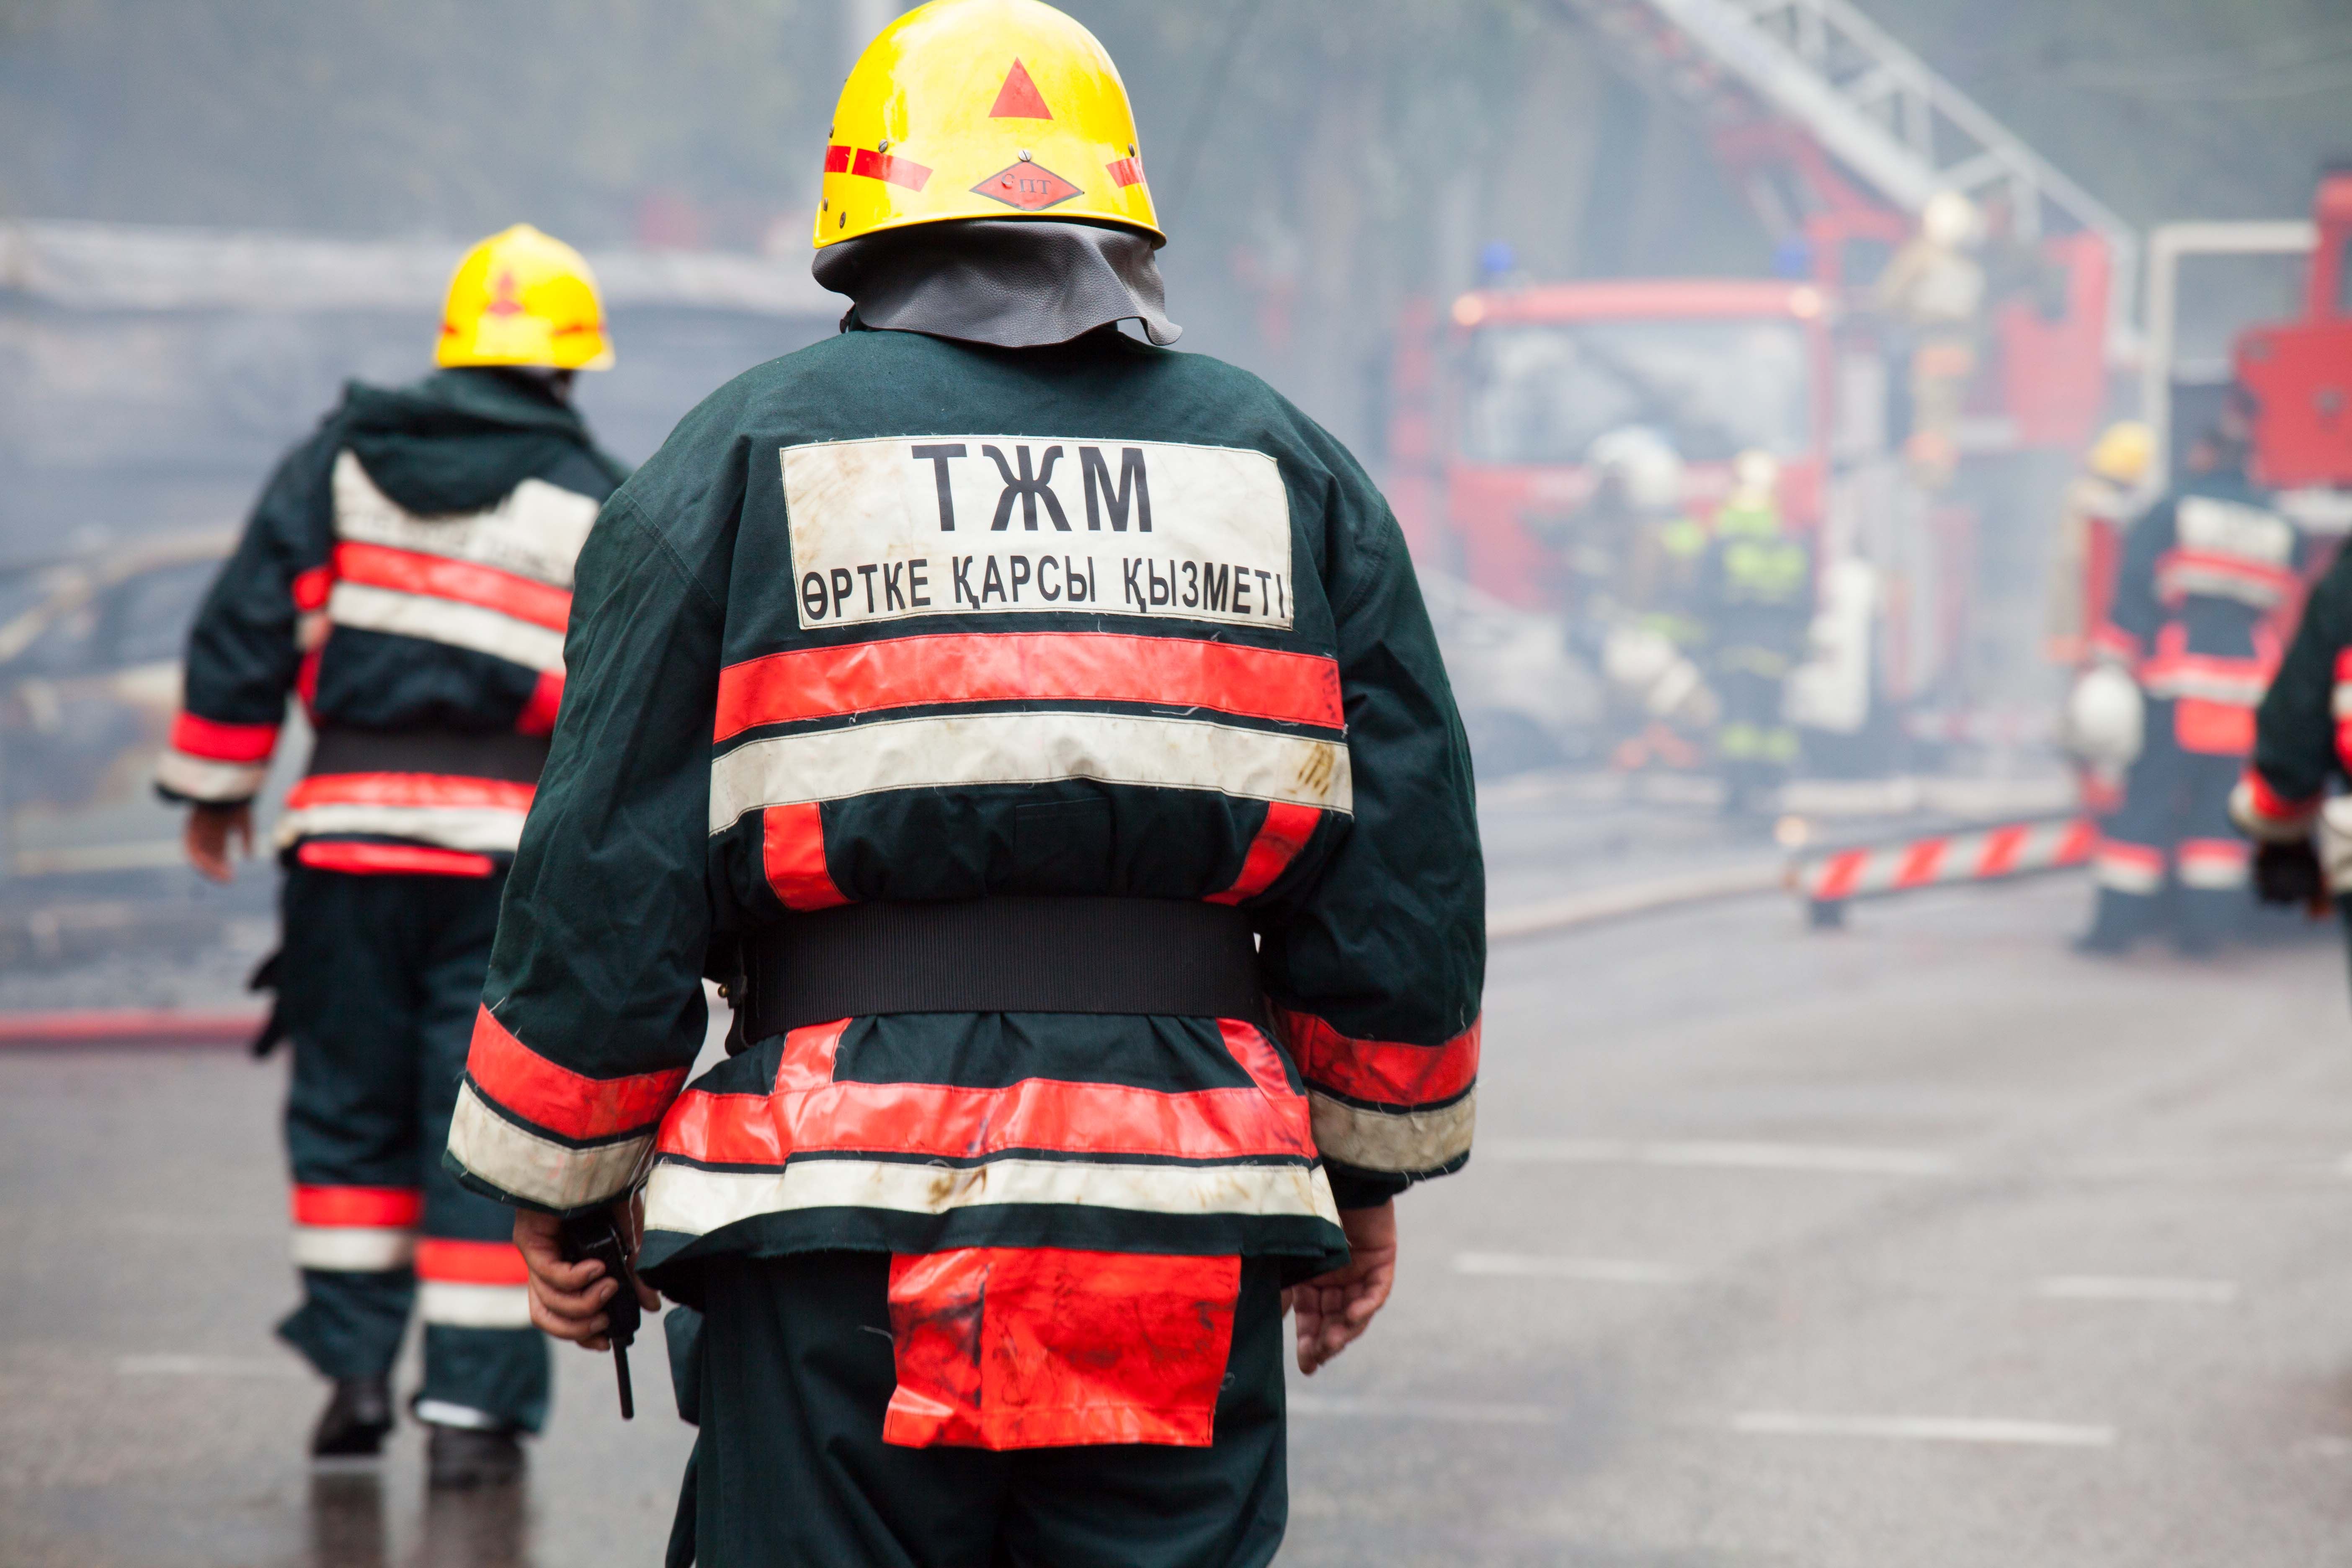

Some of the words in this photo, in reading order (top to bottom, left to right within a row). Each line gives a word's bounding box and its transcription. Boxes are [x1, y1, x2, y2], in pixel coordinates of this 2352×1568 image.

[1001, 173, 1052, 194] СПТ
[912, 444, 1153, 532] ТЖМ
[802, 559, 931, 620] ӨРТКЕ
[952, 555, 1096, 609] ҚАРСЫ
[1123, 557, 1285, 619] ҚЫЗМЕТІ
